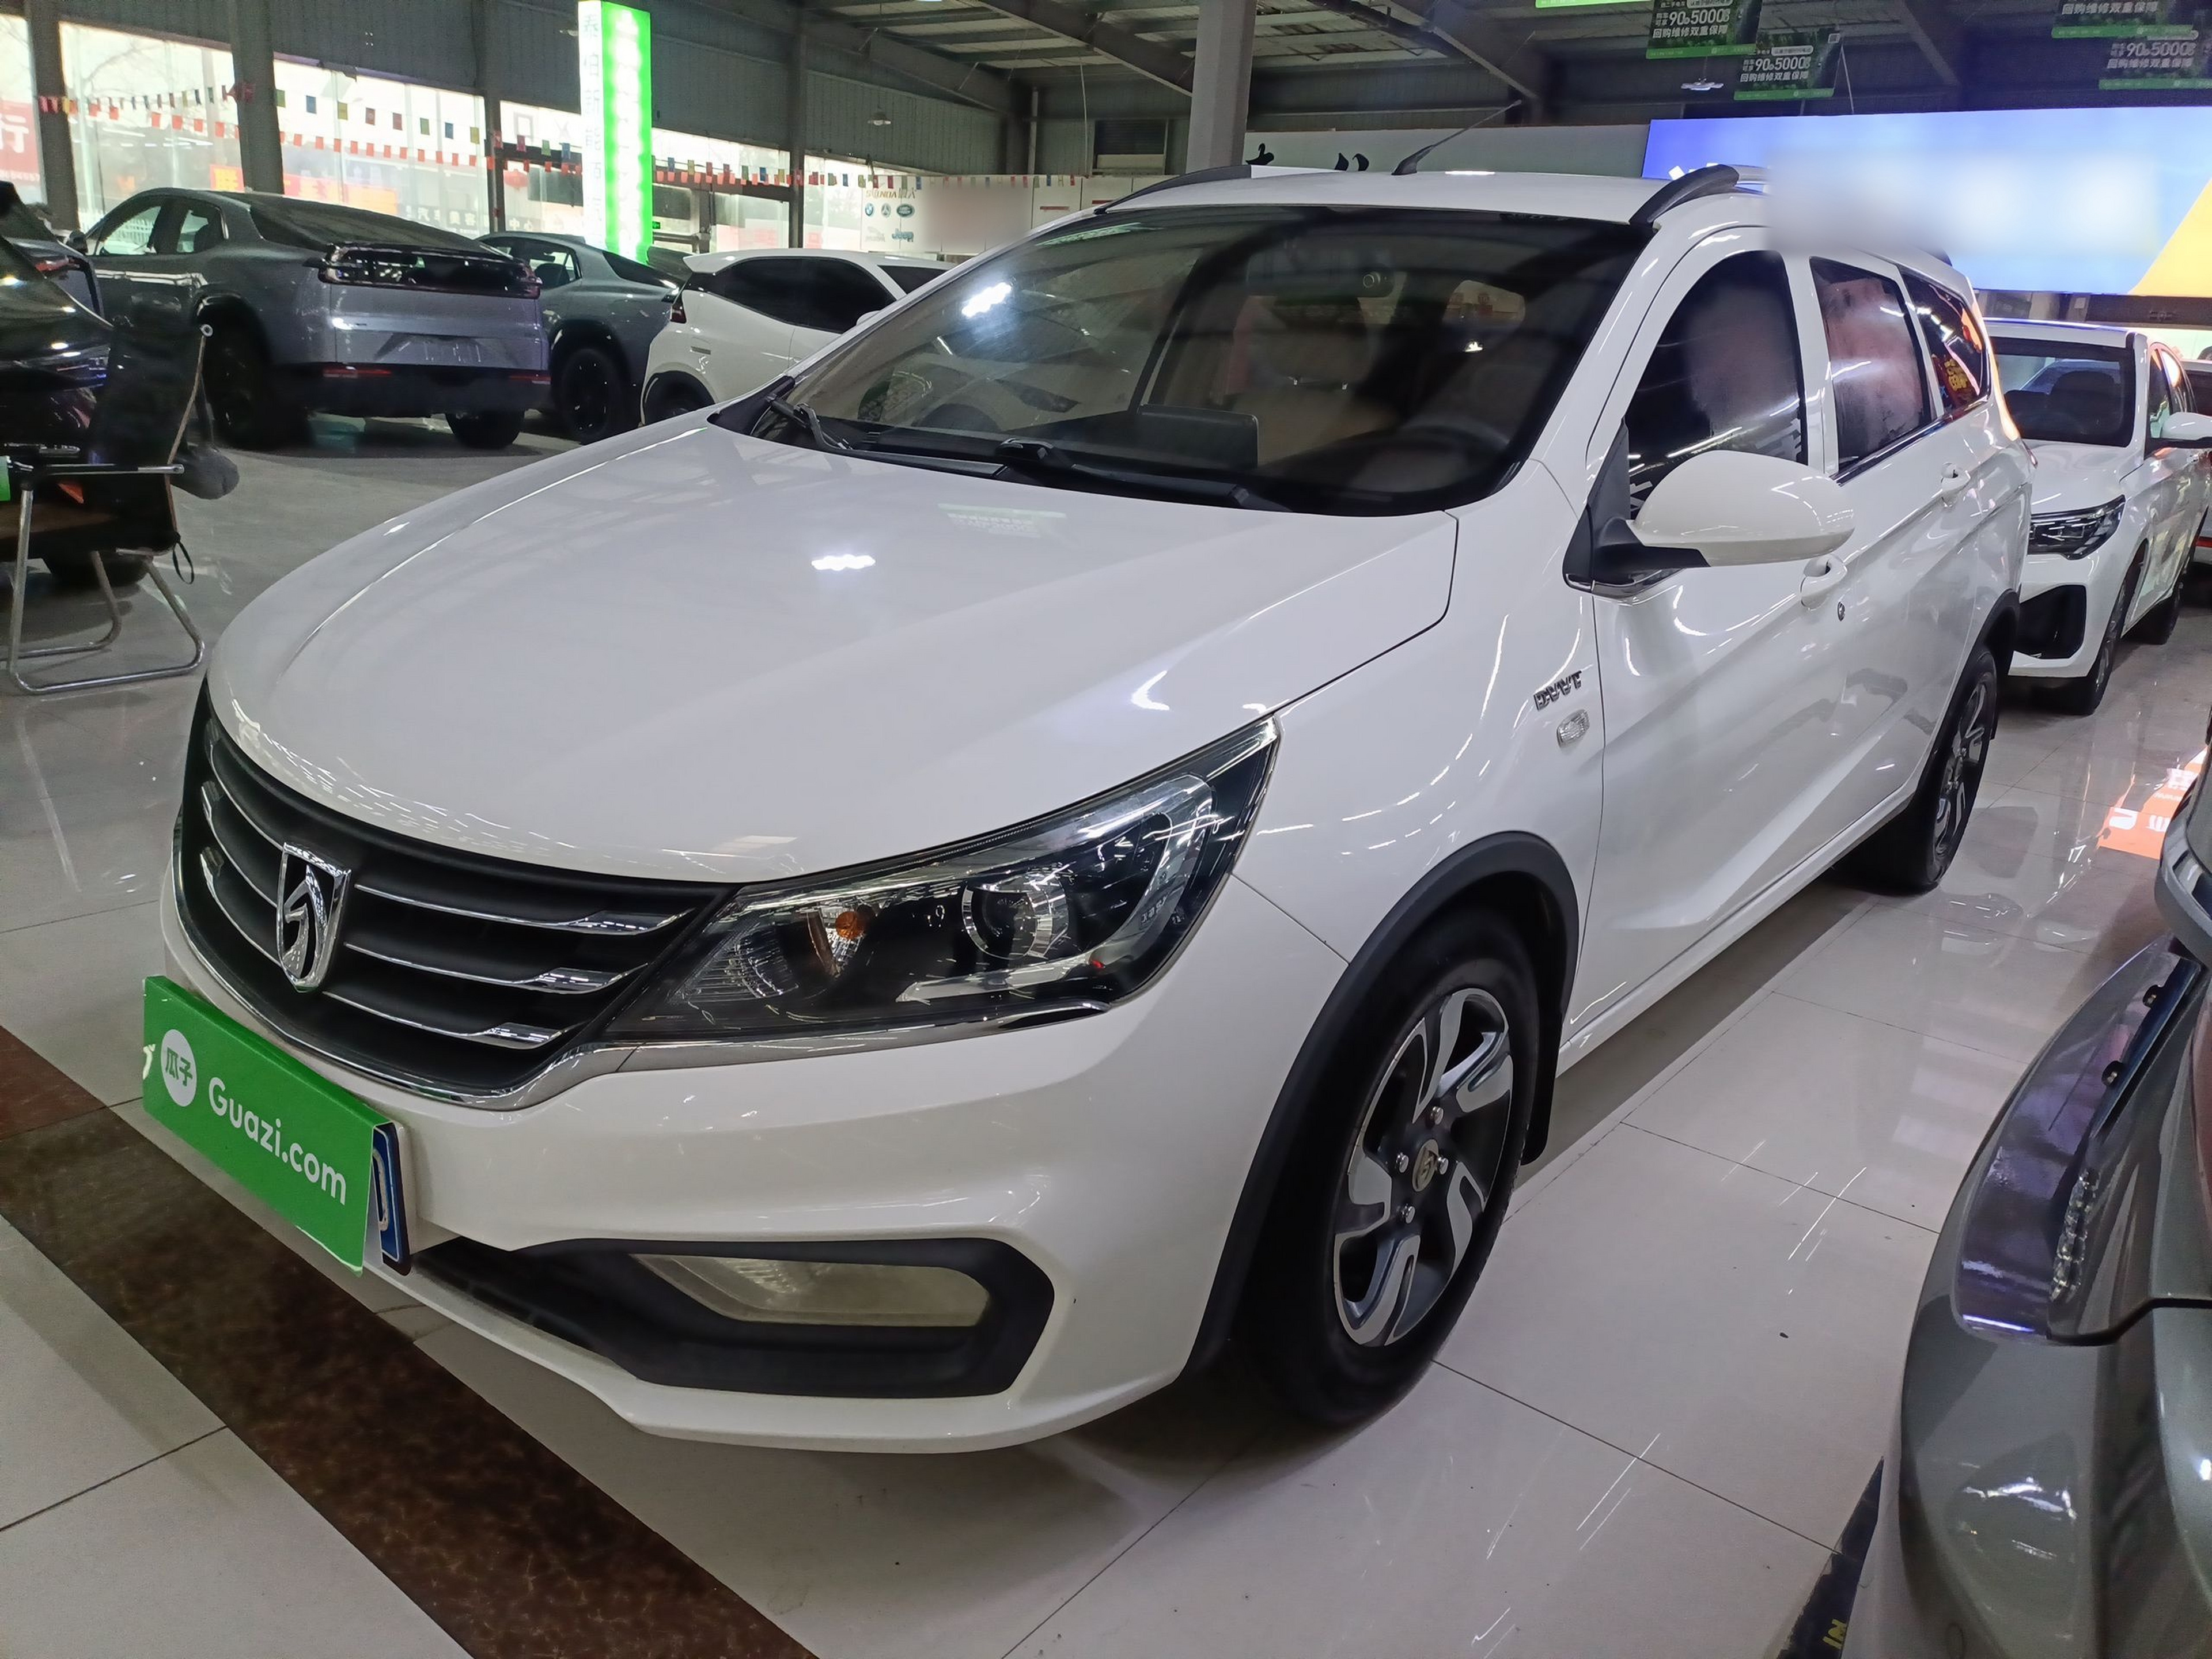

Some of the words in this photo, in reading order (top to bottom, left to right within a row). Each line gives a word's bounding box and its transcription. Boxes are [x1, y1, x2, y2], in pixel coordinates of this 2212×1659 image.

[1652, 25, 1729, 39] 回购维修双重保障
[1740, 70, 1809, 83] 回购维修双重保障
[1533, 671, 1582, 711] DVVT
[165, 1047, 193, 1087] 瓜子
[209, 1077, 346, 1206] Guazi.com
